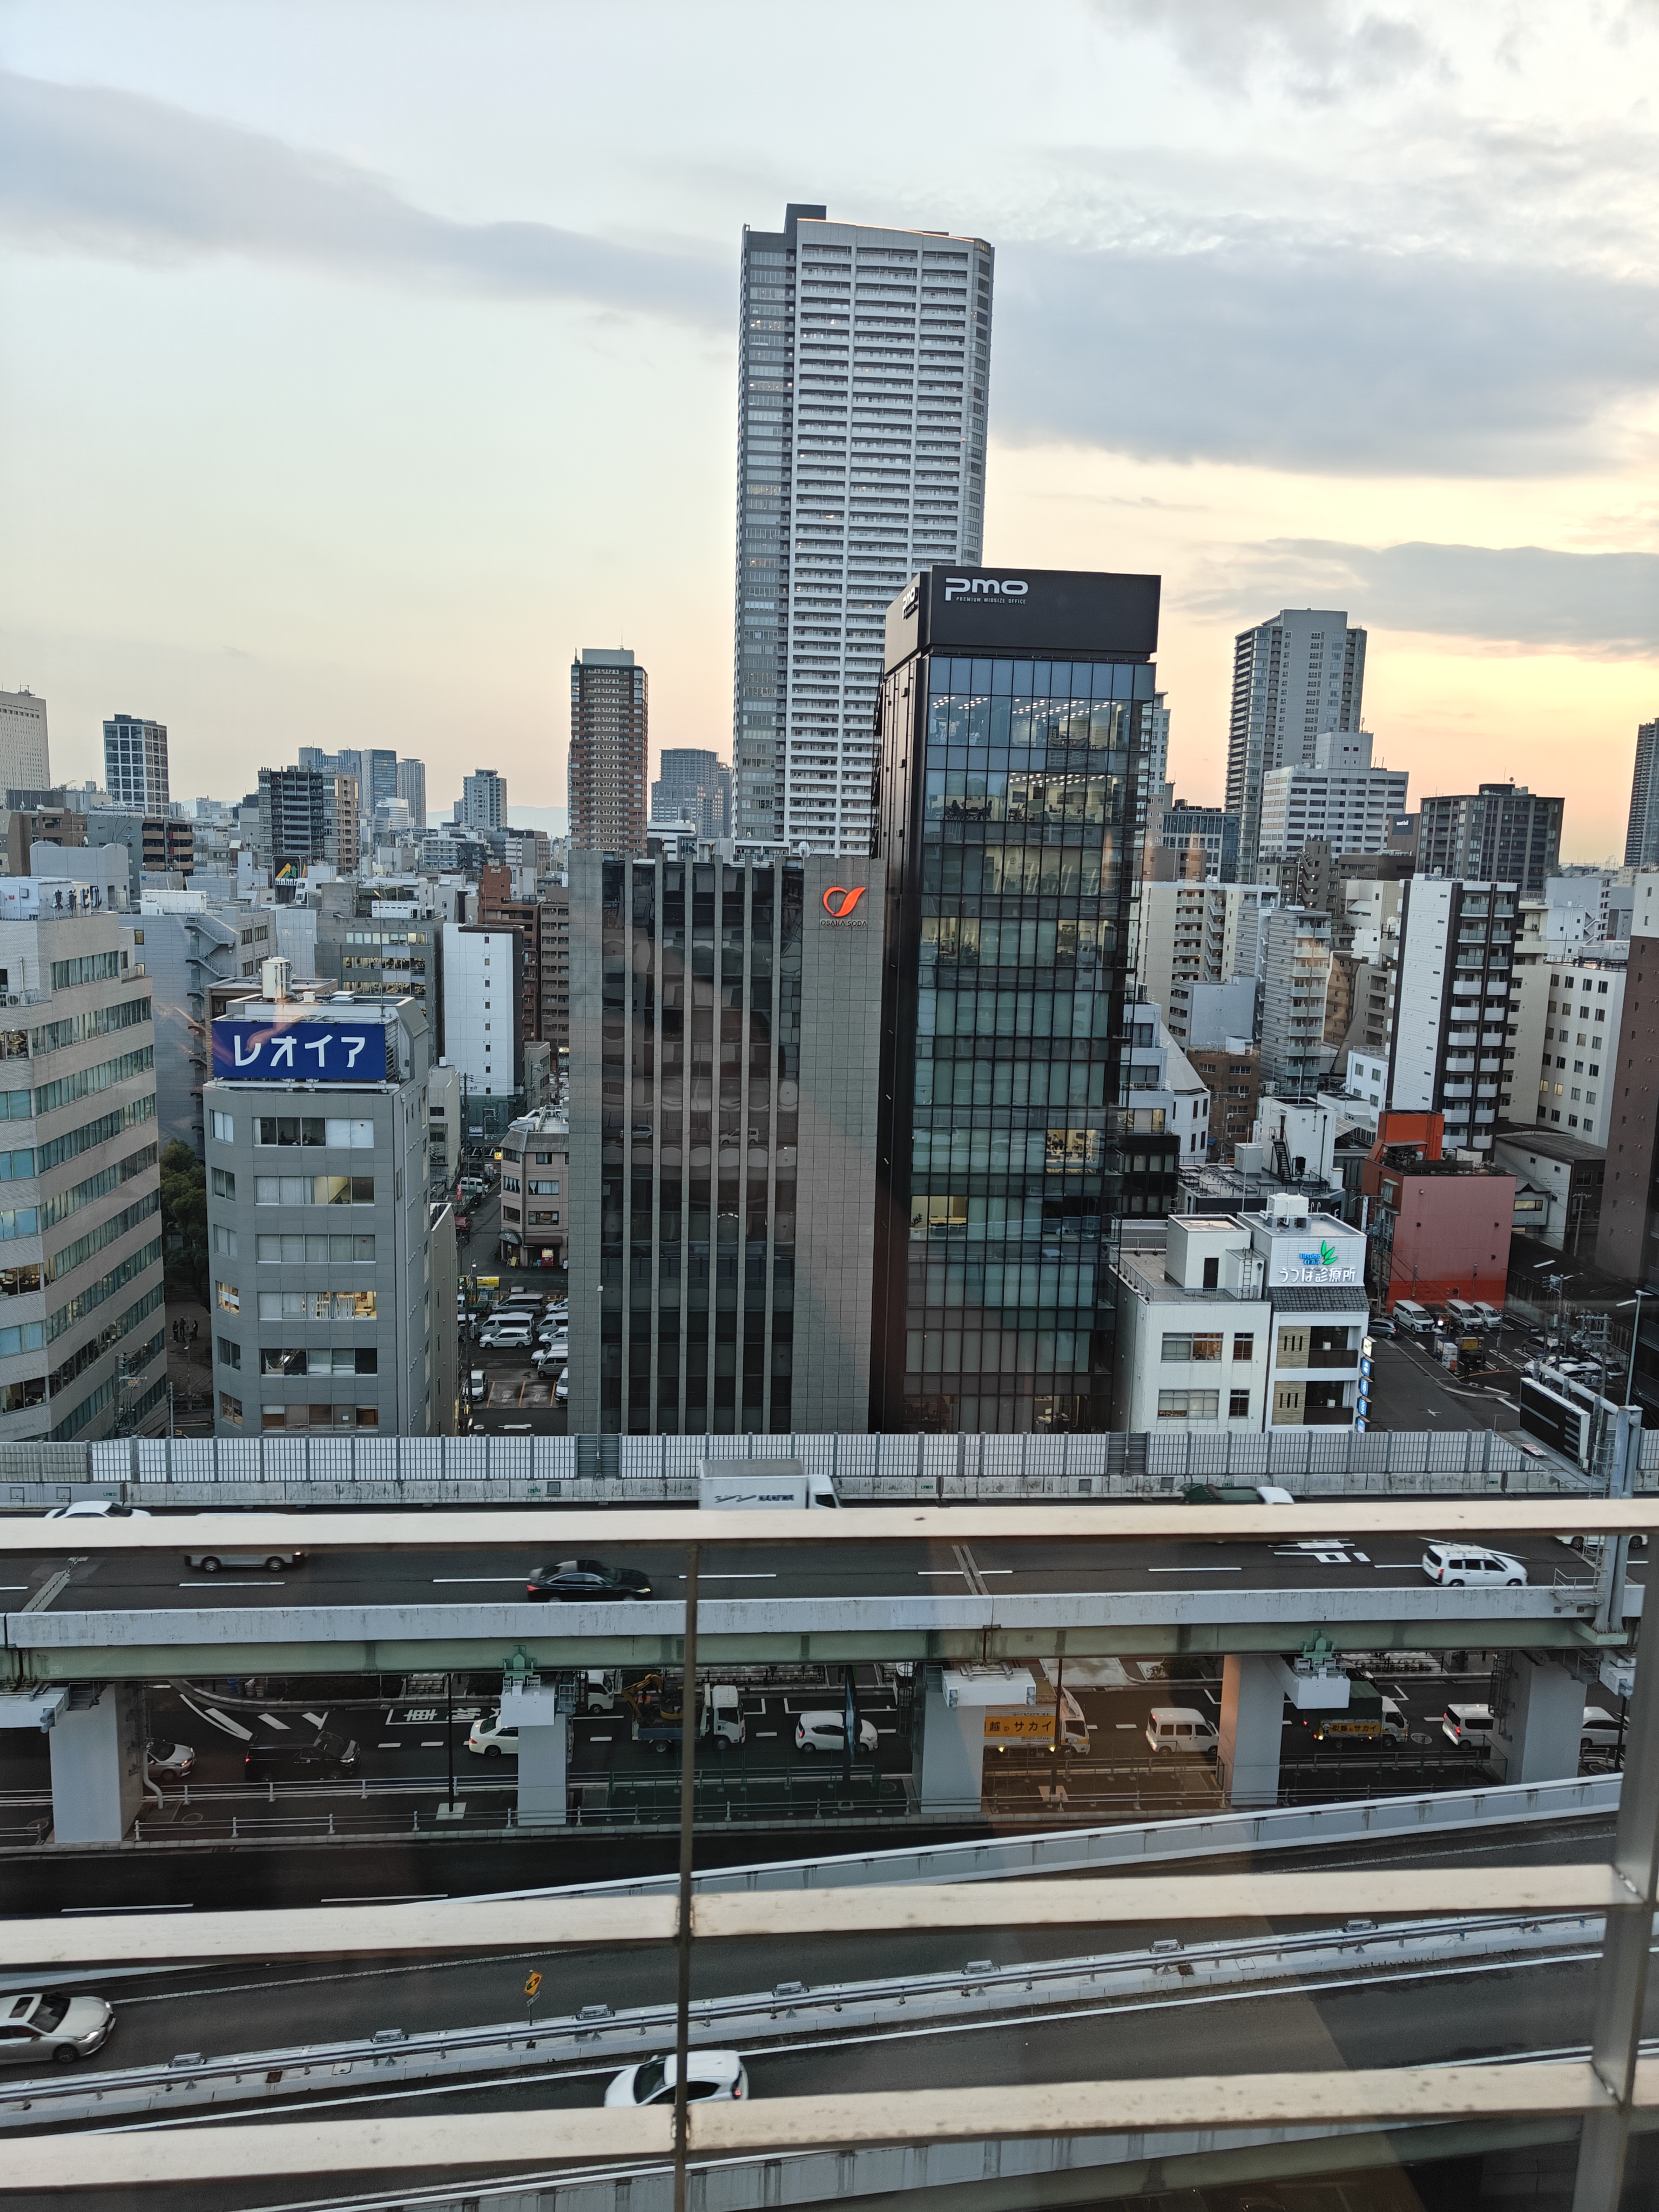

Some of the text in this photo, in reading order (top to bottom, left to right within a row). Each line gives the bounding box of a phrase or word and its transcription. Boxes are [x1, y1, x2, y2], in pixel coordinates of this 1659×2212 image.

[945, 577, 1029, 601] pmo
[234, 1034, 365, 1068] レオイア
[984, 1721, 1051, 1732] 越のサカイ
